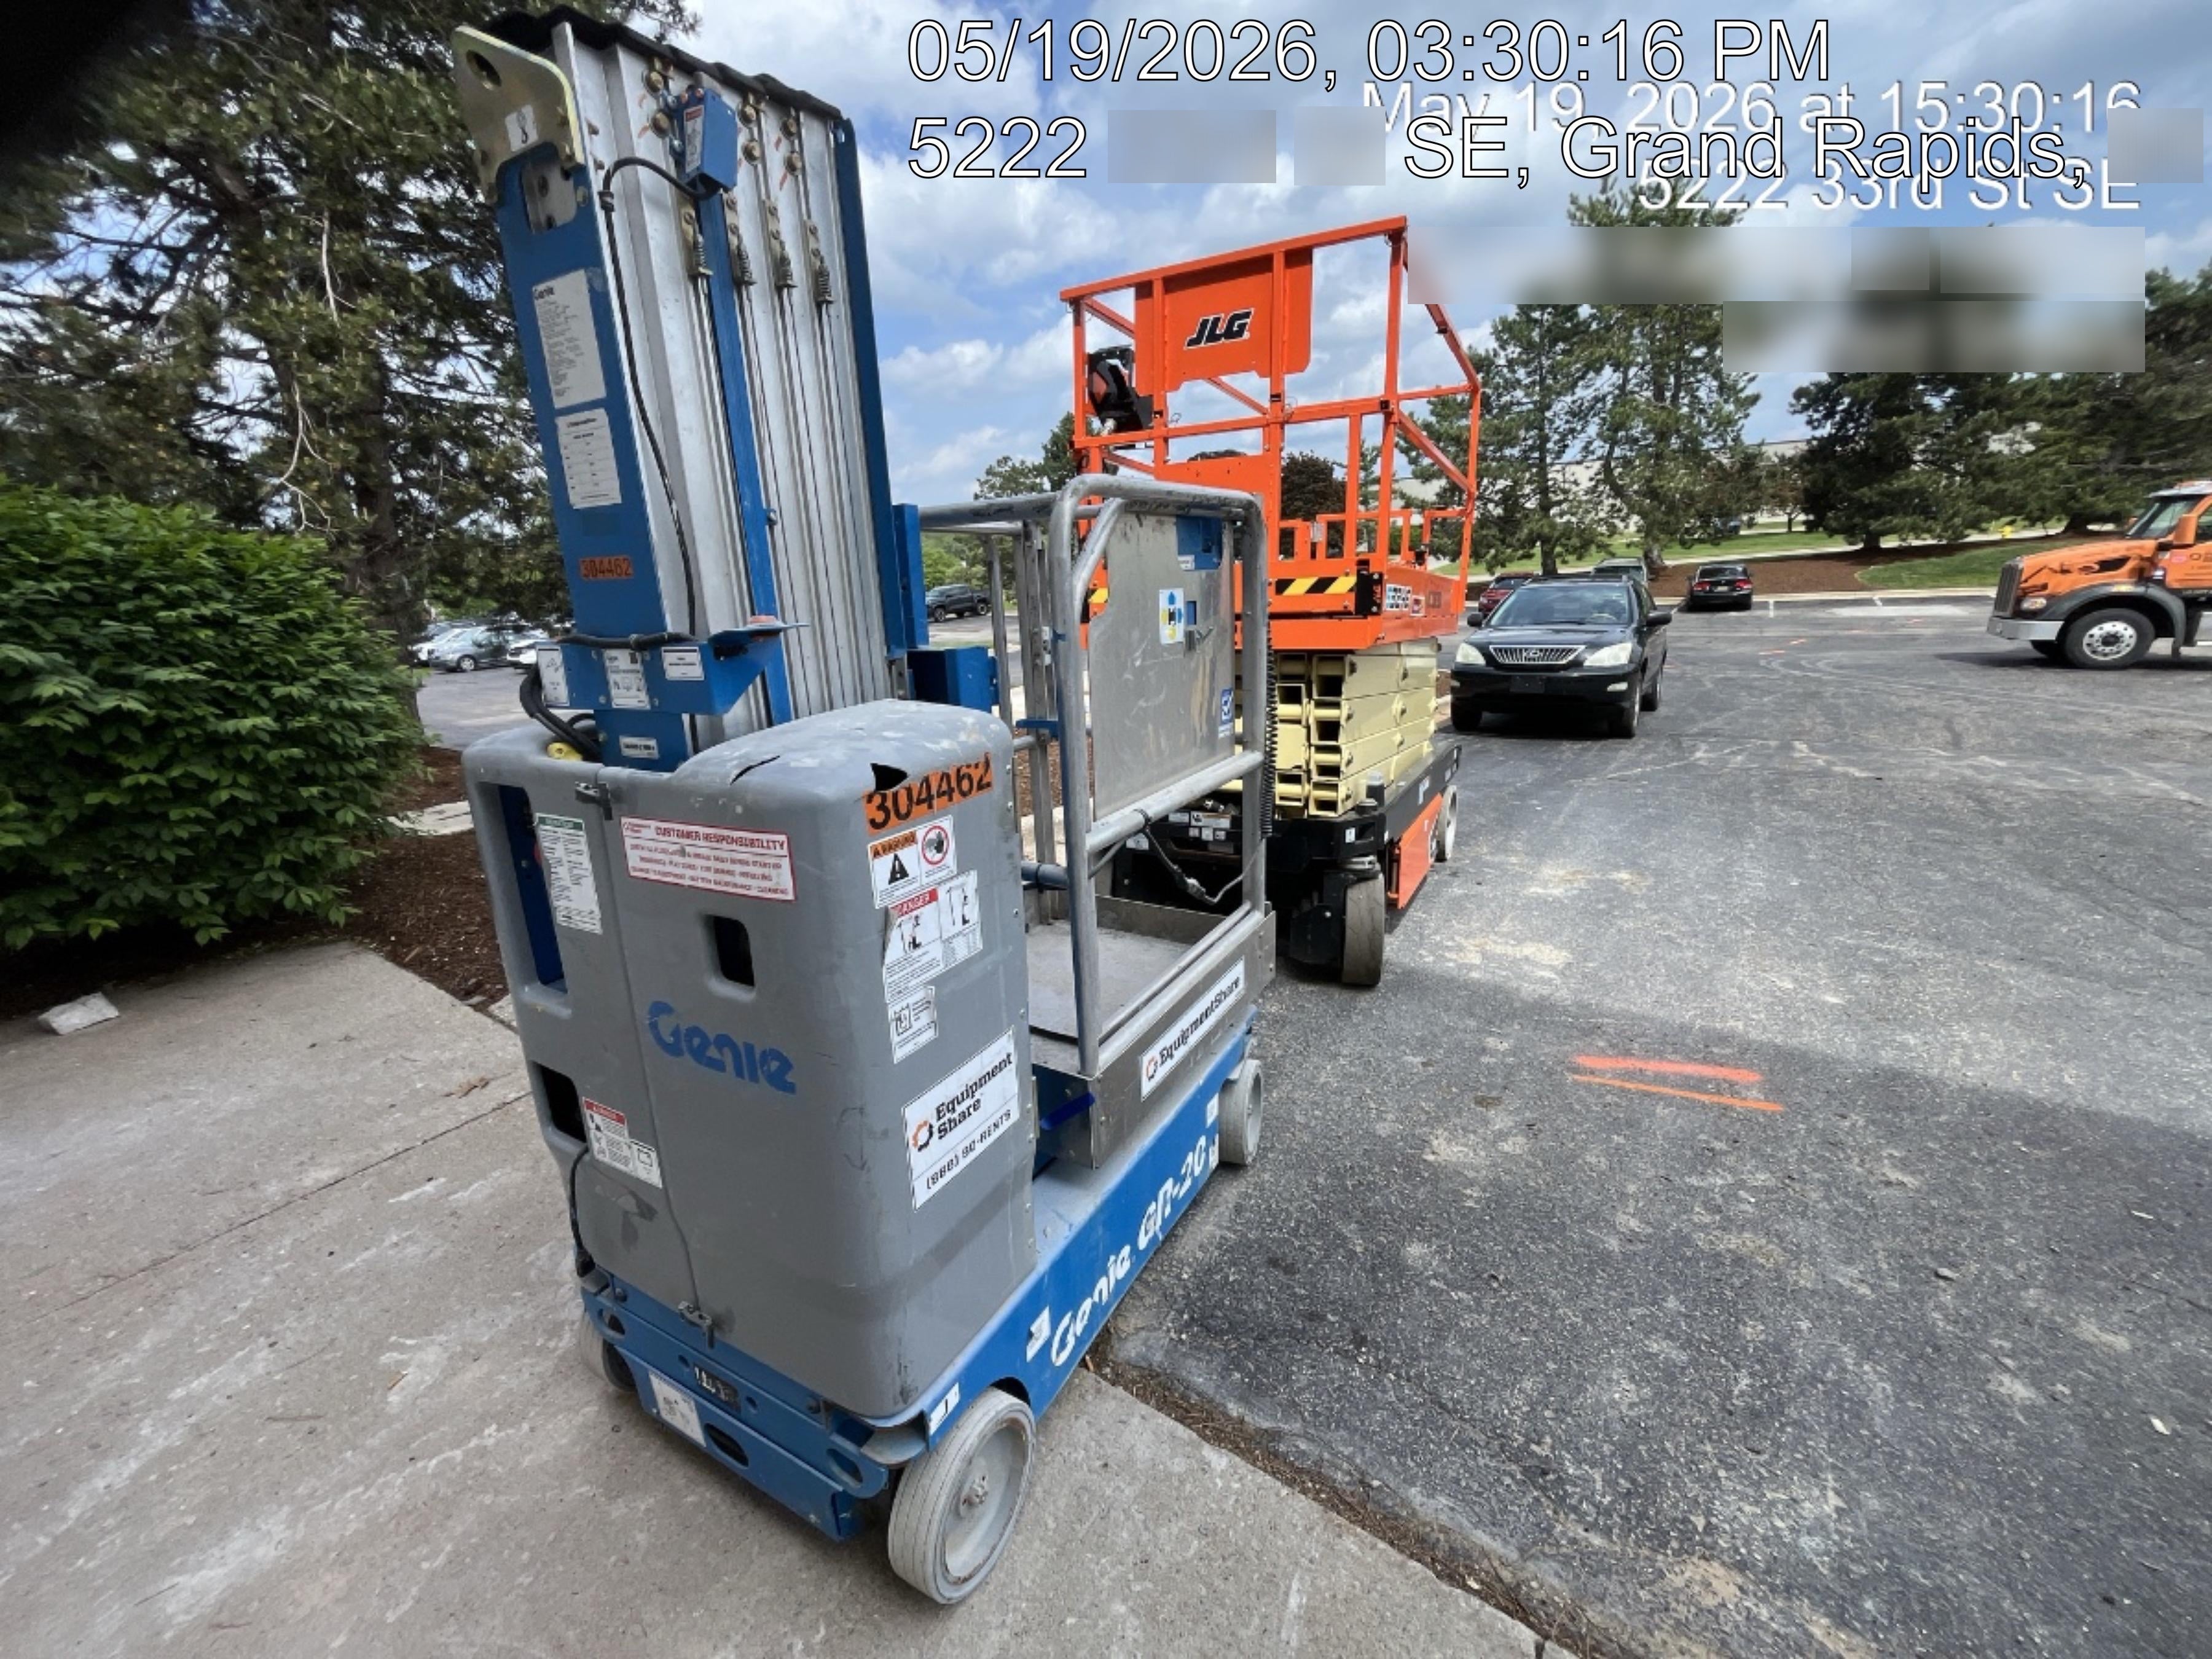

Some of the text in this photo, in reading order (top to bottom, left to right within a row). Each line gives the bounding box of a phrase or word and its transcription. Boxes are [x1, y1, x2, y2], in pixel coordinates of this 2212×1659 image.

[1184, 308, 1254, 349] JLG
[581, 559, 632, 578] 304462
[866, 753, 992, 830] 304462
[656, 826, 702, 842] CUSTOMER
[702, 833, 786, 851] RESPONSIBILITY
[648, 1000, 796, 1095] Genie
[1159, 976, 1240, 1067] EquipmentShare
[935, 1052, 1013, 1122] Equipment
[937, 1097, 982, 1140] Share
[1050, 1244, 1132, 1367] Genie
